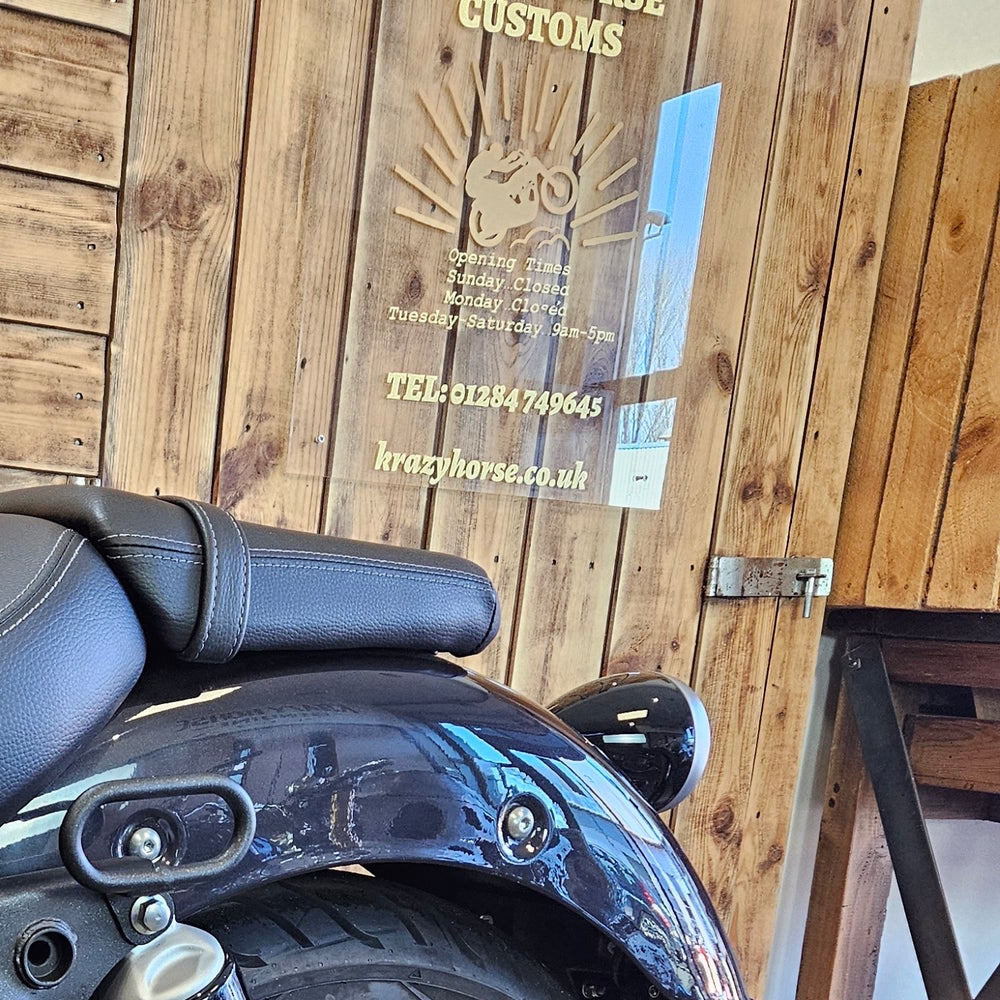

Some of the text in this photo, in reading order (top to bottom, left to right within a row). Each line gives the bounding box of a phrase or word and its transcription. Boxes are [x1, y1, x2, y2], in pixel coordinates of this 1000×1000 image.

[458, 0, 624, 57] CUSTOMS
[448, 248, 572, 276] Opening Times
[386, 372, 603, 420] TEL: 01284 749645
[374, 441, 589, 490] krazyhorse.co.uk
